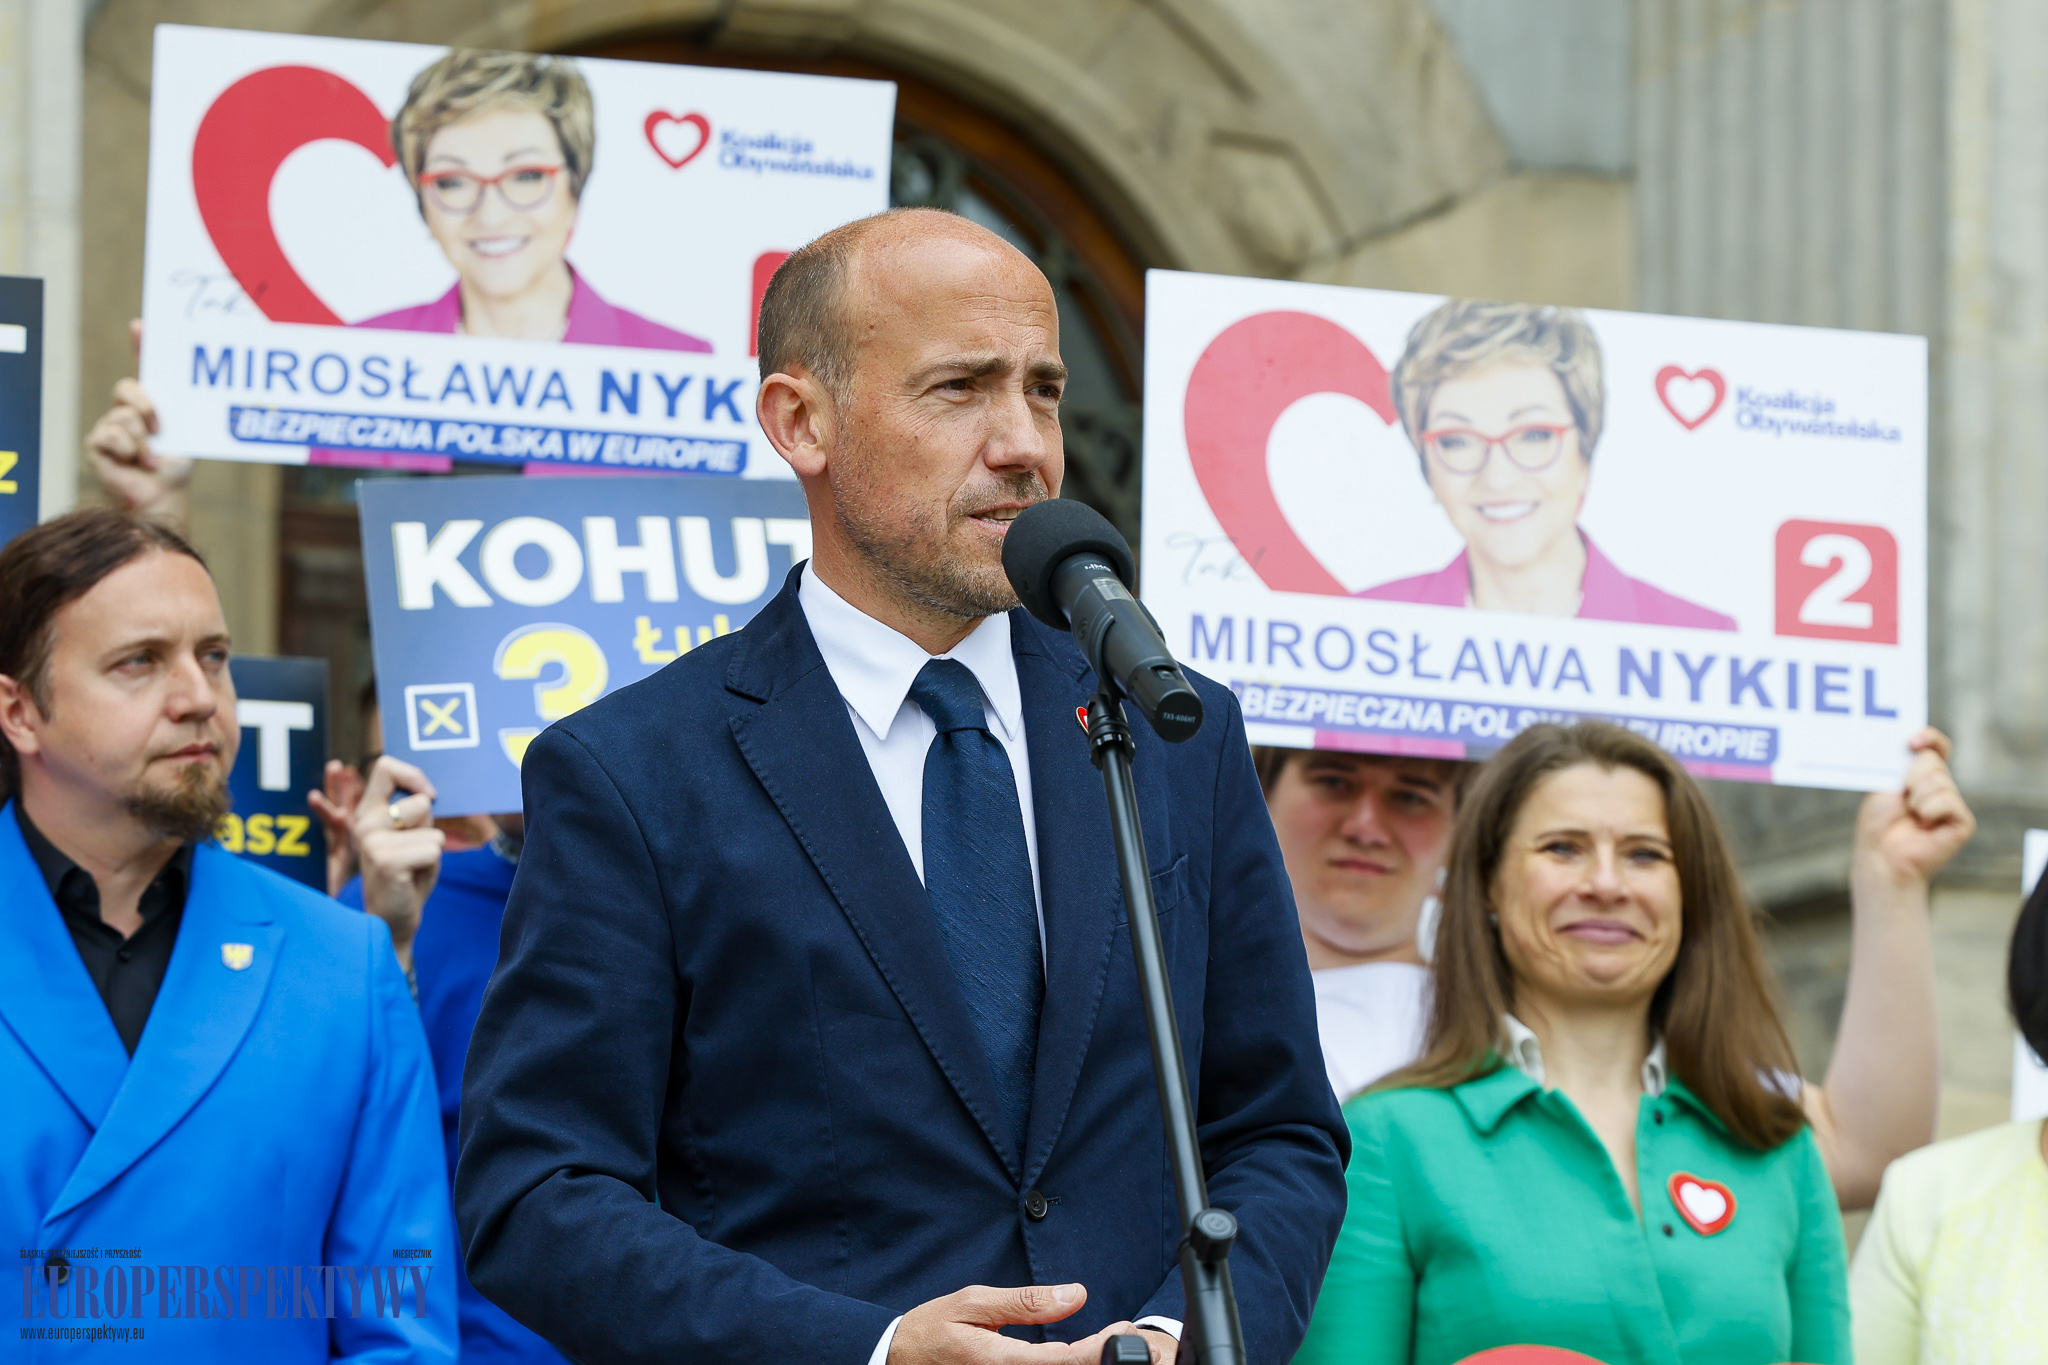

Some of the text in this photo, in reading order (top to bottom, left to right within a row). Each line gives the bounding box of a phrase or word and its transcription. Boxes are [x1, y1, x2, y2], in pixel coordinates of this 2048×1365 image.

[191, 345, 575, 412] MIROSŁAWA
[1736, 386, 1835, 414] Koalicja
[235, 407, 742, 472] BEZPIECZNA POLSKA W EUROPIE
[1736, 406, 1901, 443] Obywatelska
[1798, 532, 1874, 629] 2
[633, 613, 745, 664] Łu
[1190, 613, 1897, 718] MIROSŁAWA NYKIEL
[493, 621, 609, 772] 3
[1242, 685, 1446, 734] BEZPIECZNA
[1448, 704, 1580, 740] POLS
